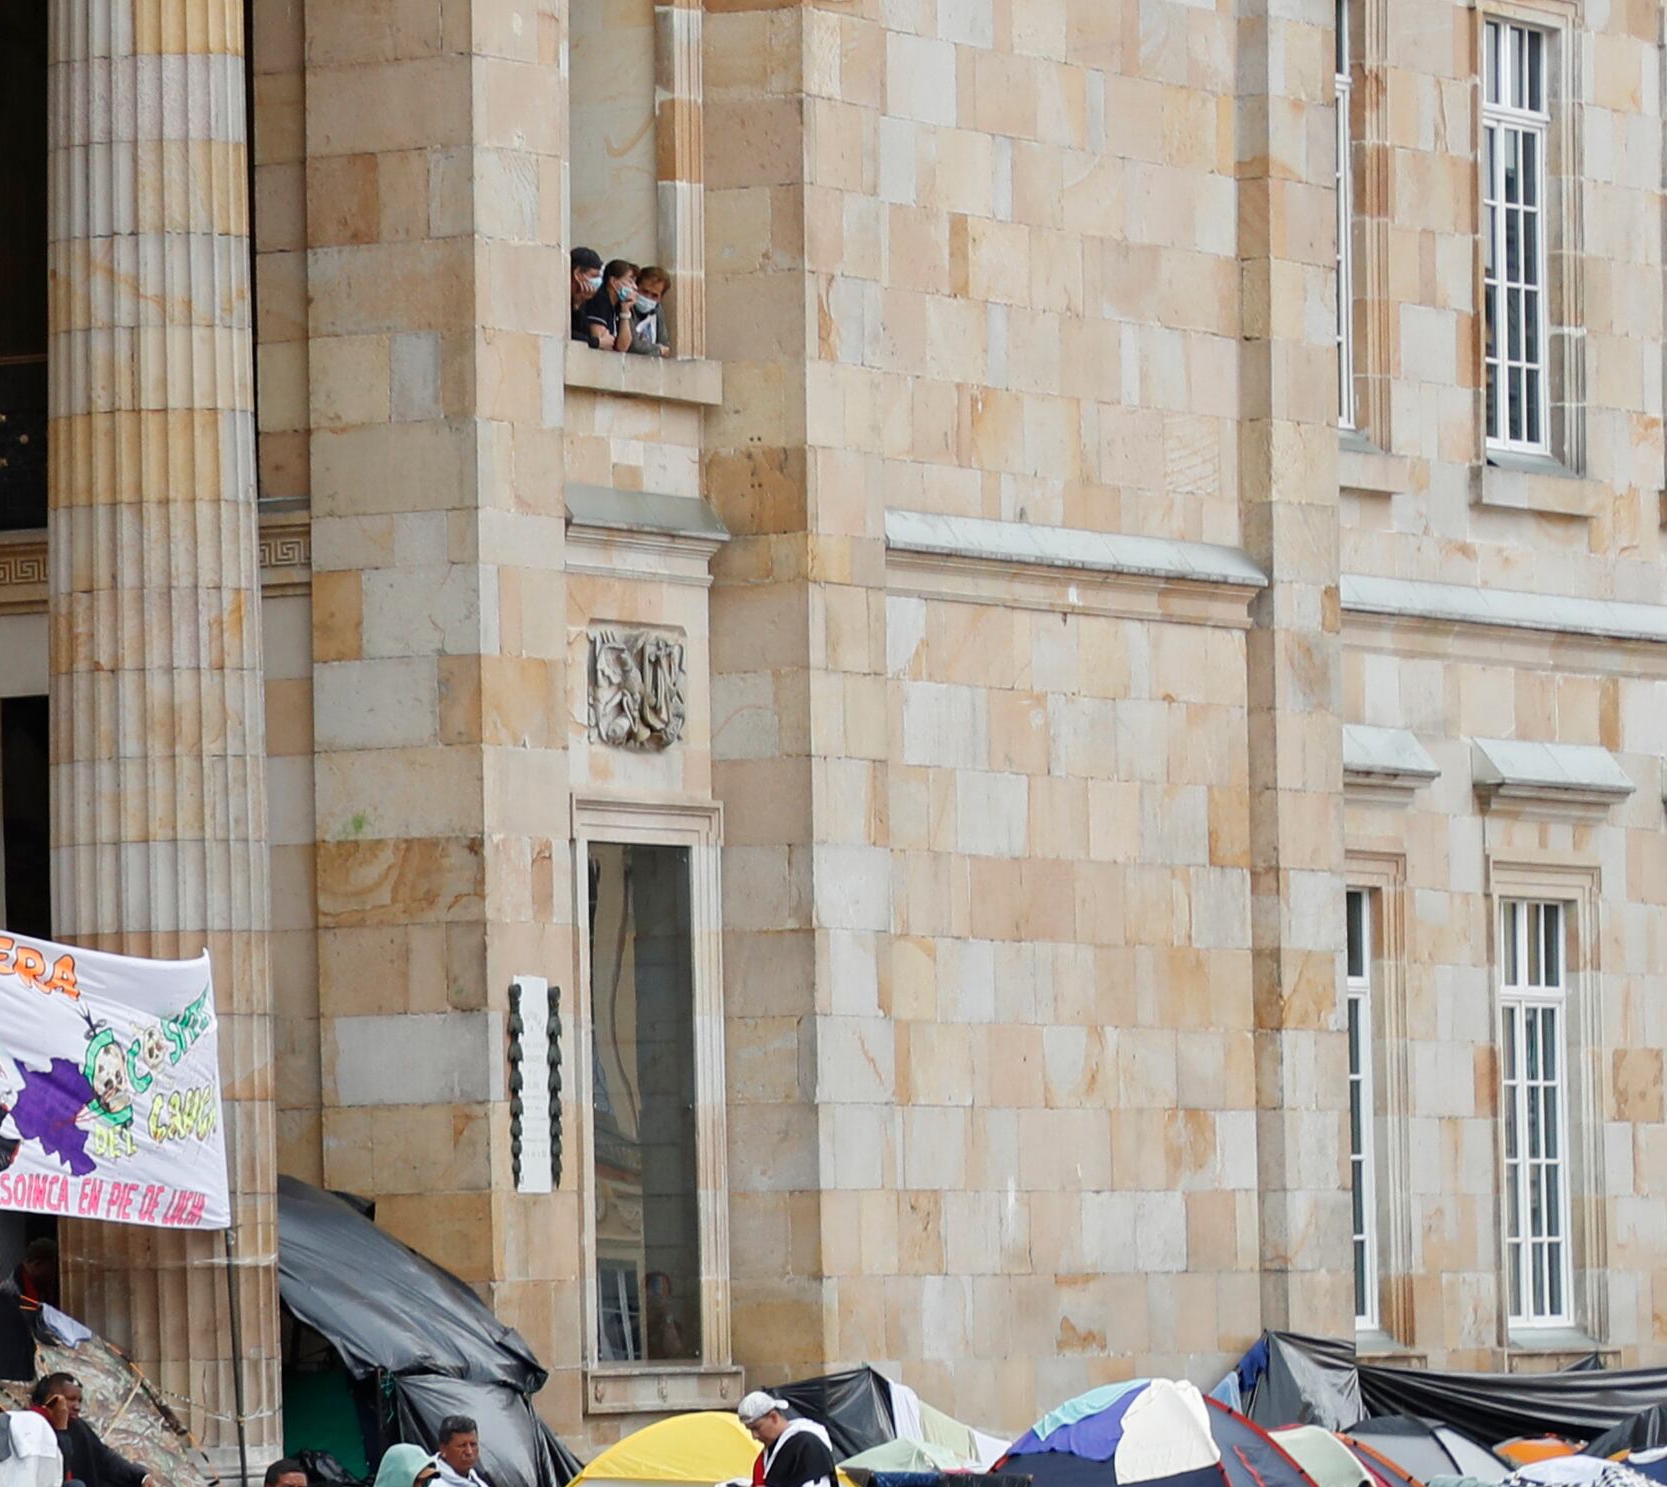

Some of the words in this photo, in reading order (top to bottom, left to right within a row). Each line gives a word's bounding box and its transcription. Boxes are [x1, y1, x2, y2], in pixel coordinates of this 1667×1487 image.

[78, 1178, 101, 1215] EN
[109, 1183, 138, 1220] PIE
[139, 1184, 164, 1222] DE
